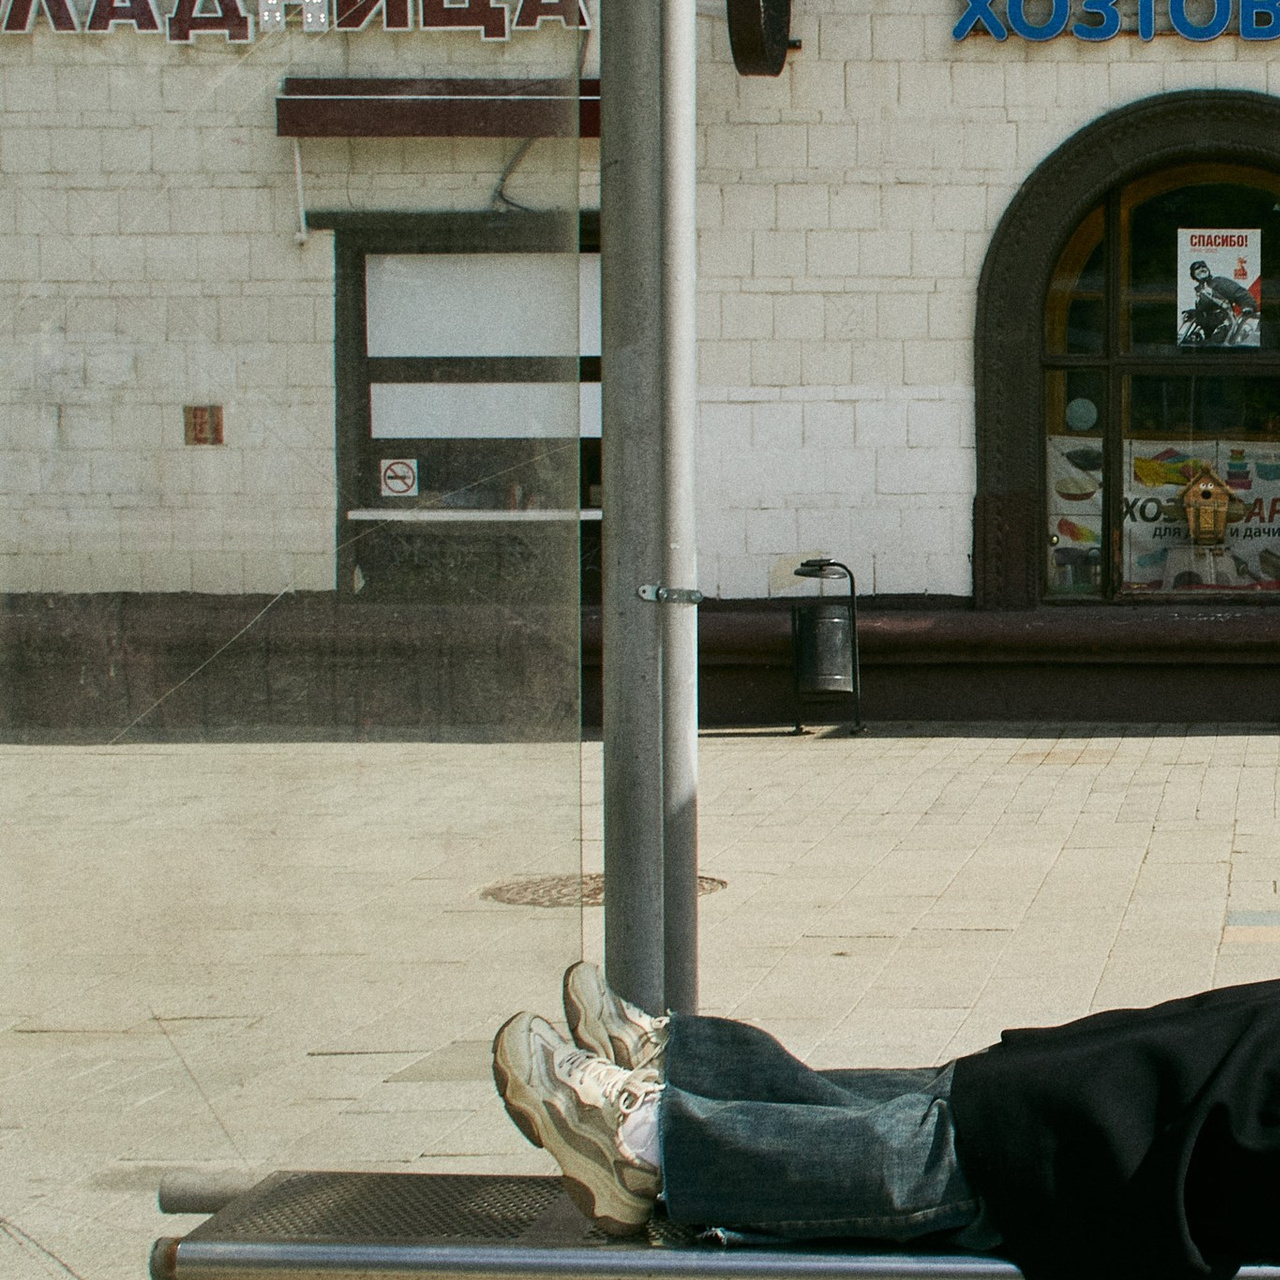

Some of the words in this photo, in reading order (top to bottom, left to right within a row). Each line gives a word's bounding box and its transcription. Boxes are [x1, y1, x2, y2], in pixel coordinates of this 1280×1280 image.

[1190, 234, 1248, 247] СПАСИБО!
[1152, 526, 1181, 539] для
[1230, 528, 1239, 538] и
[1243, 526, 1280, 539] дачи
